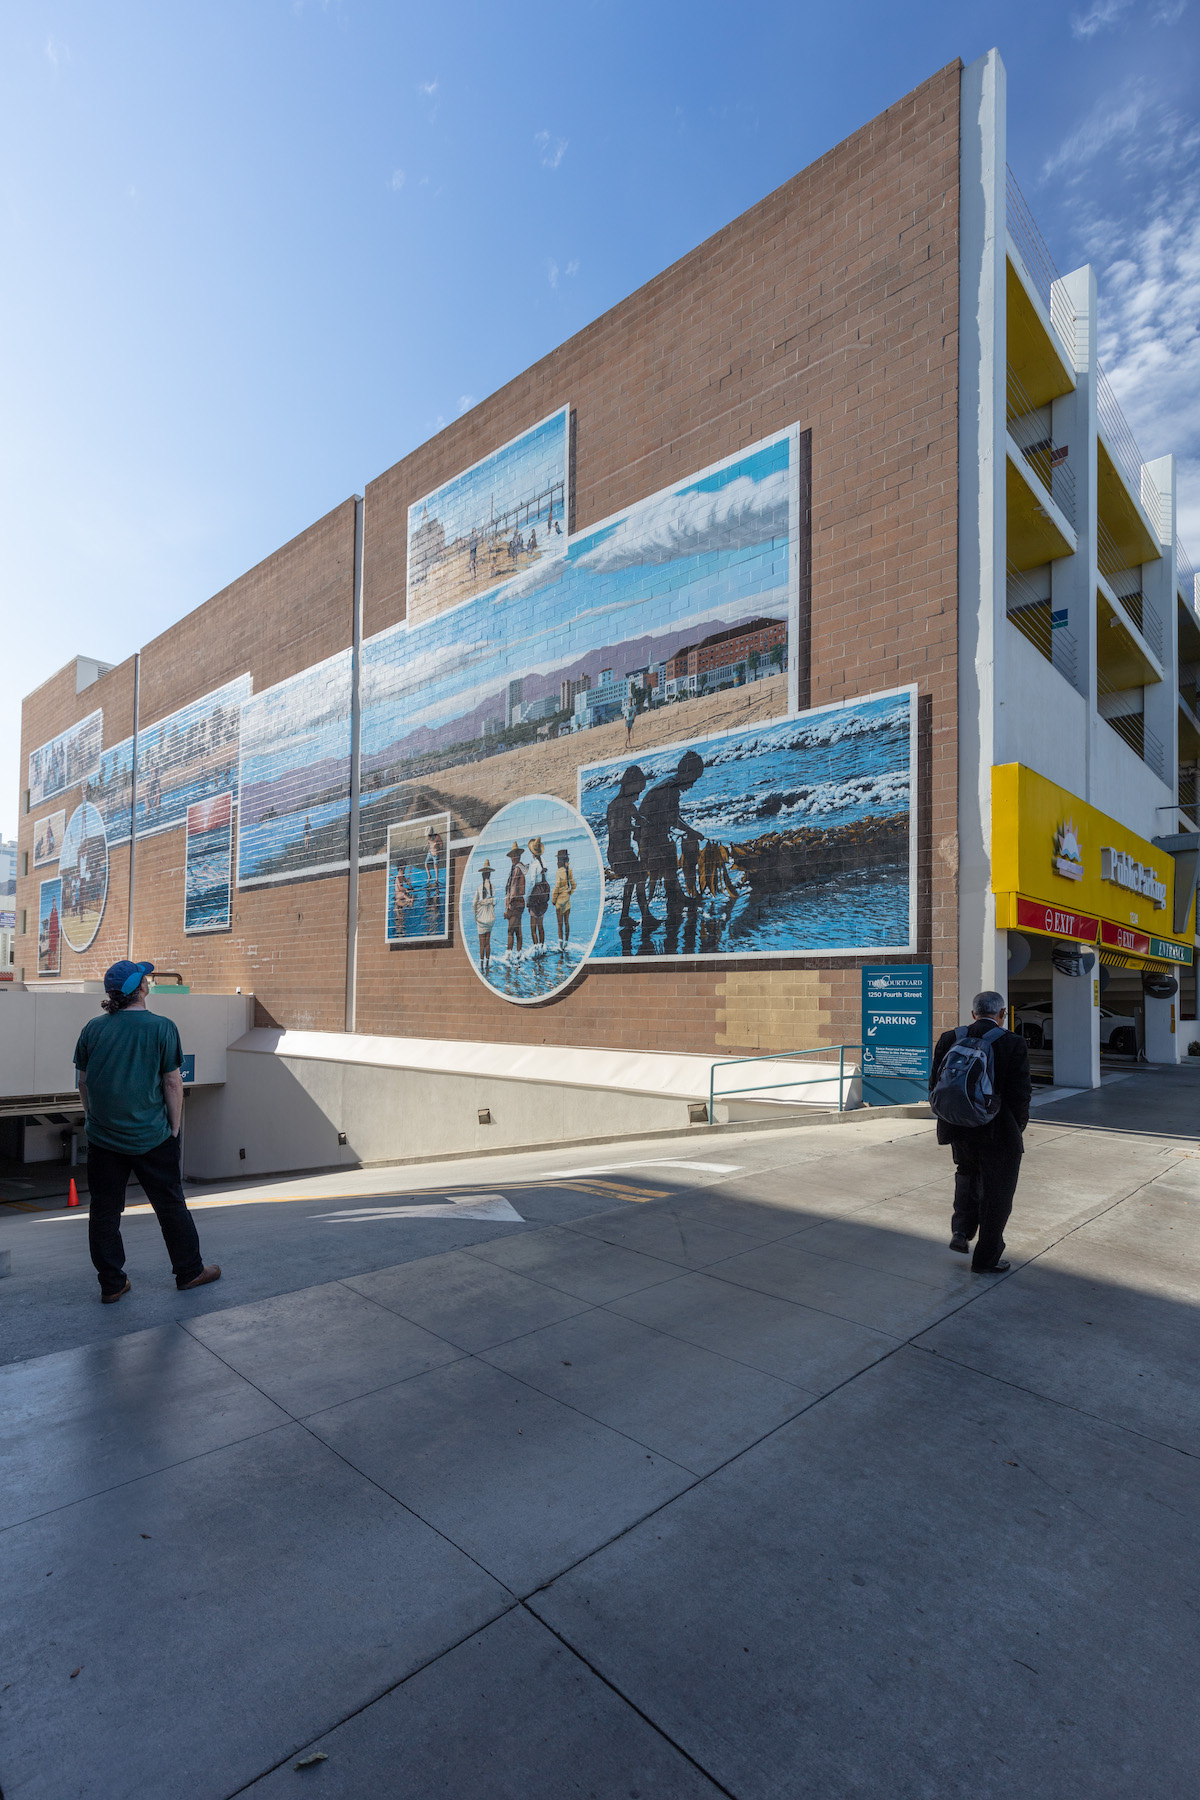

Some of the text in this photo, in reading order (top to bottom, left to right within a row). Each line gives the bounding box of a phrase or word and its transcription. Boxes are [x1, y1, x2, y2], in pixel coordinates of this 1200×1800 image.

[1109, 847, 1167, 911] Public Parking
[1054, 912, 1075, 934] EXIT
[1123, 931, 1135, 950] EXIT
[872, 1016, 916, 1025] PARKING
